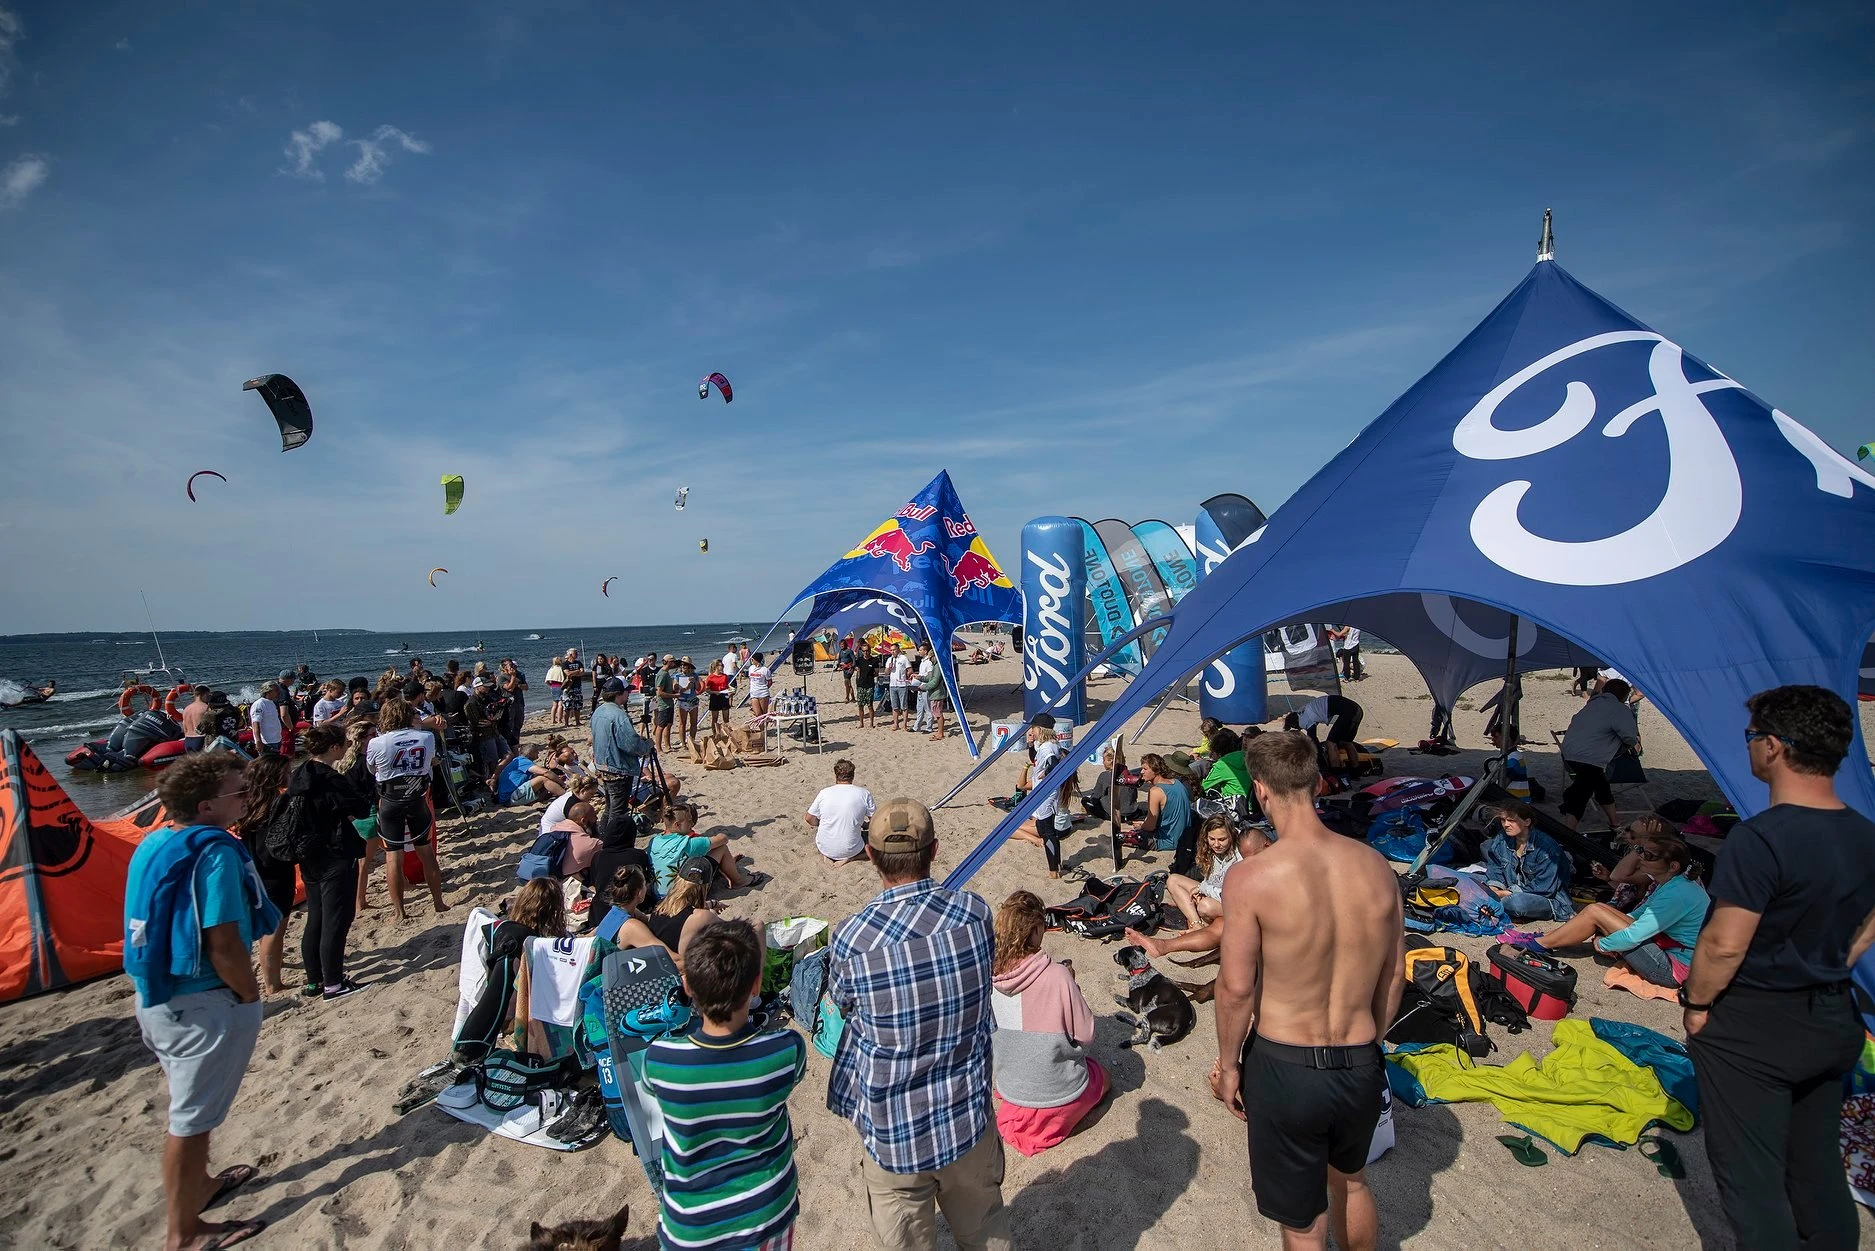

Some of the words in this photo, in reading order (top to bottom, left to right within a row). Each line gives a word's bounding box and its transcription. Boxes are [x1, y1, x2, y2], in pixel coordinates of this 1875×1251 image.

[897, 503, 938, 521] Bull
[943, 514, 977, 538] Red
[1022, 550, 1071, 708] Ford
[392, 747, 427, 772] 43
[602, 1068, 613, 1085] 13
